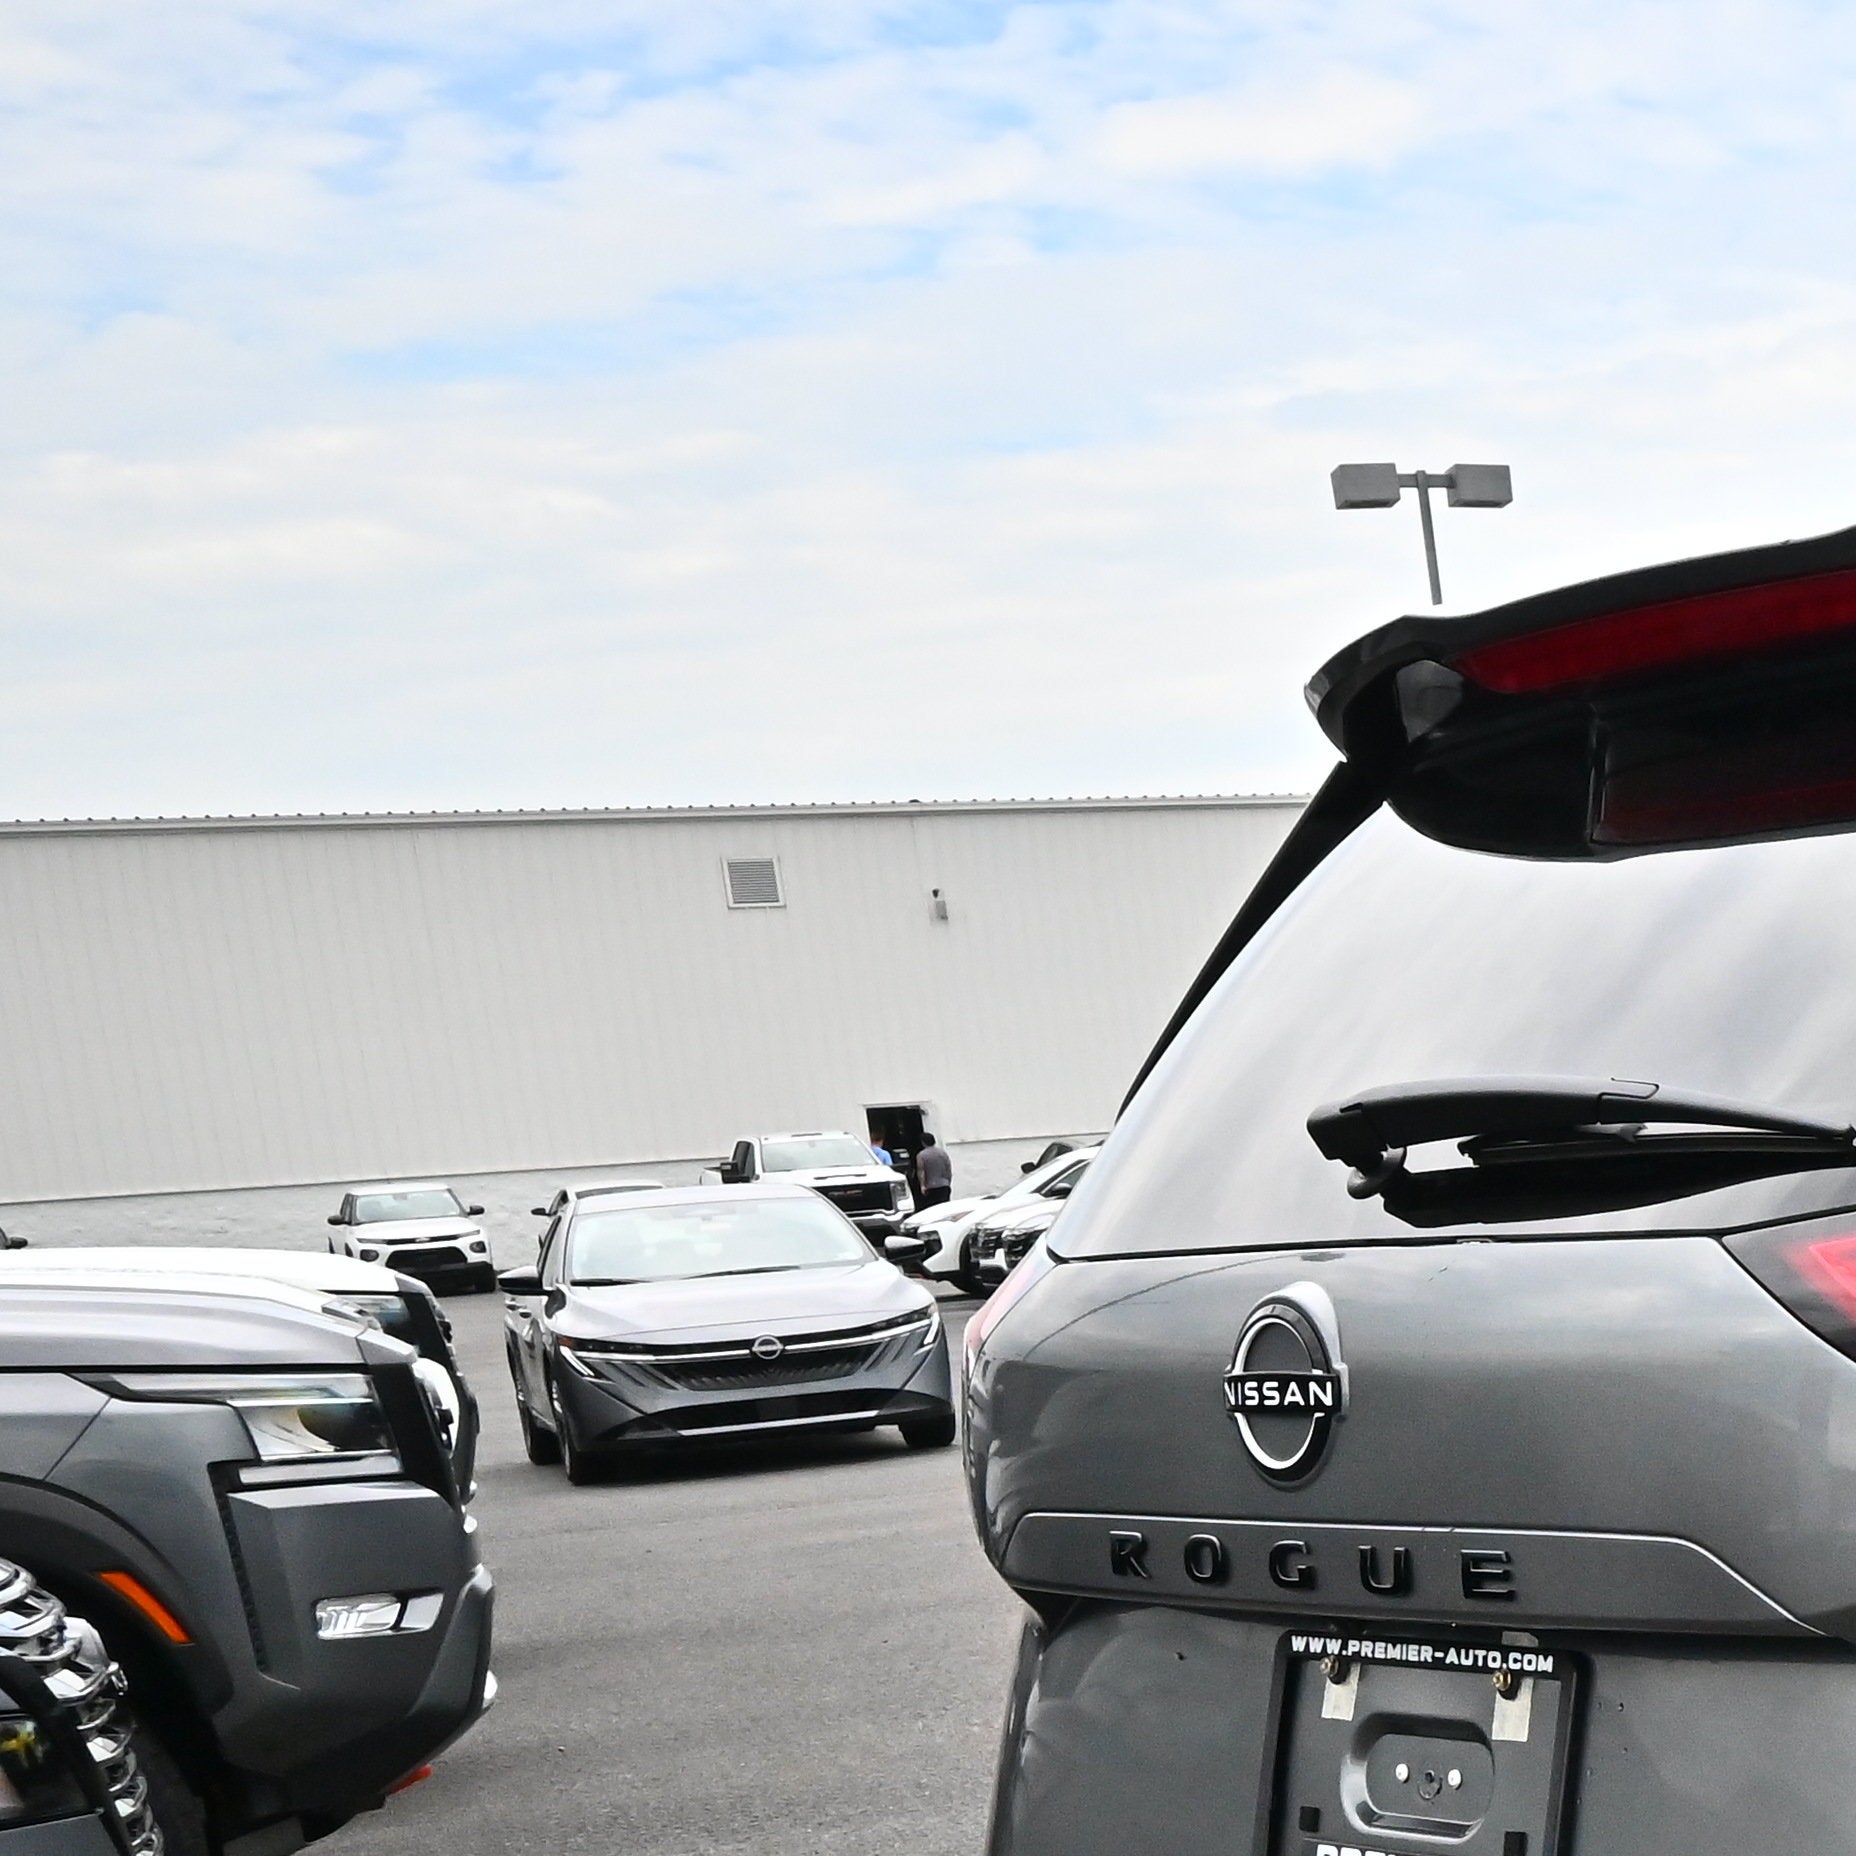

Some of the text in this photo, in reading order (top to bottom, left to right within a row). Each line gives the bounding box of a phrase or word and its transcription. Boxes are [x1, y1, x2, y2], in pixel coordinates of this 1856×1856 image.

[1224, 1381, 1333, 1406] NISSAN
[1109, 1530, 1516, 1599] ROGUE
[1291, 1635, 1554, 1673] WWW.PREMIER-AUTO.COM
